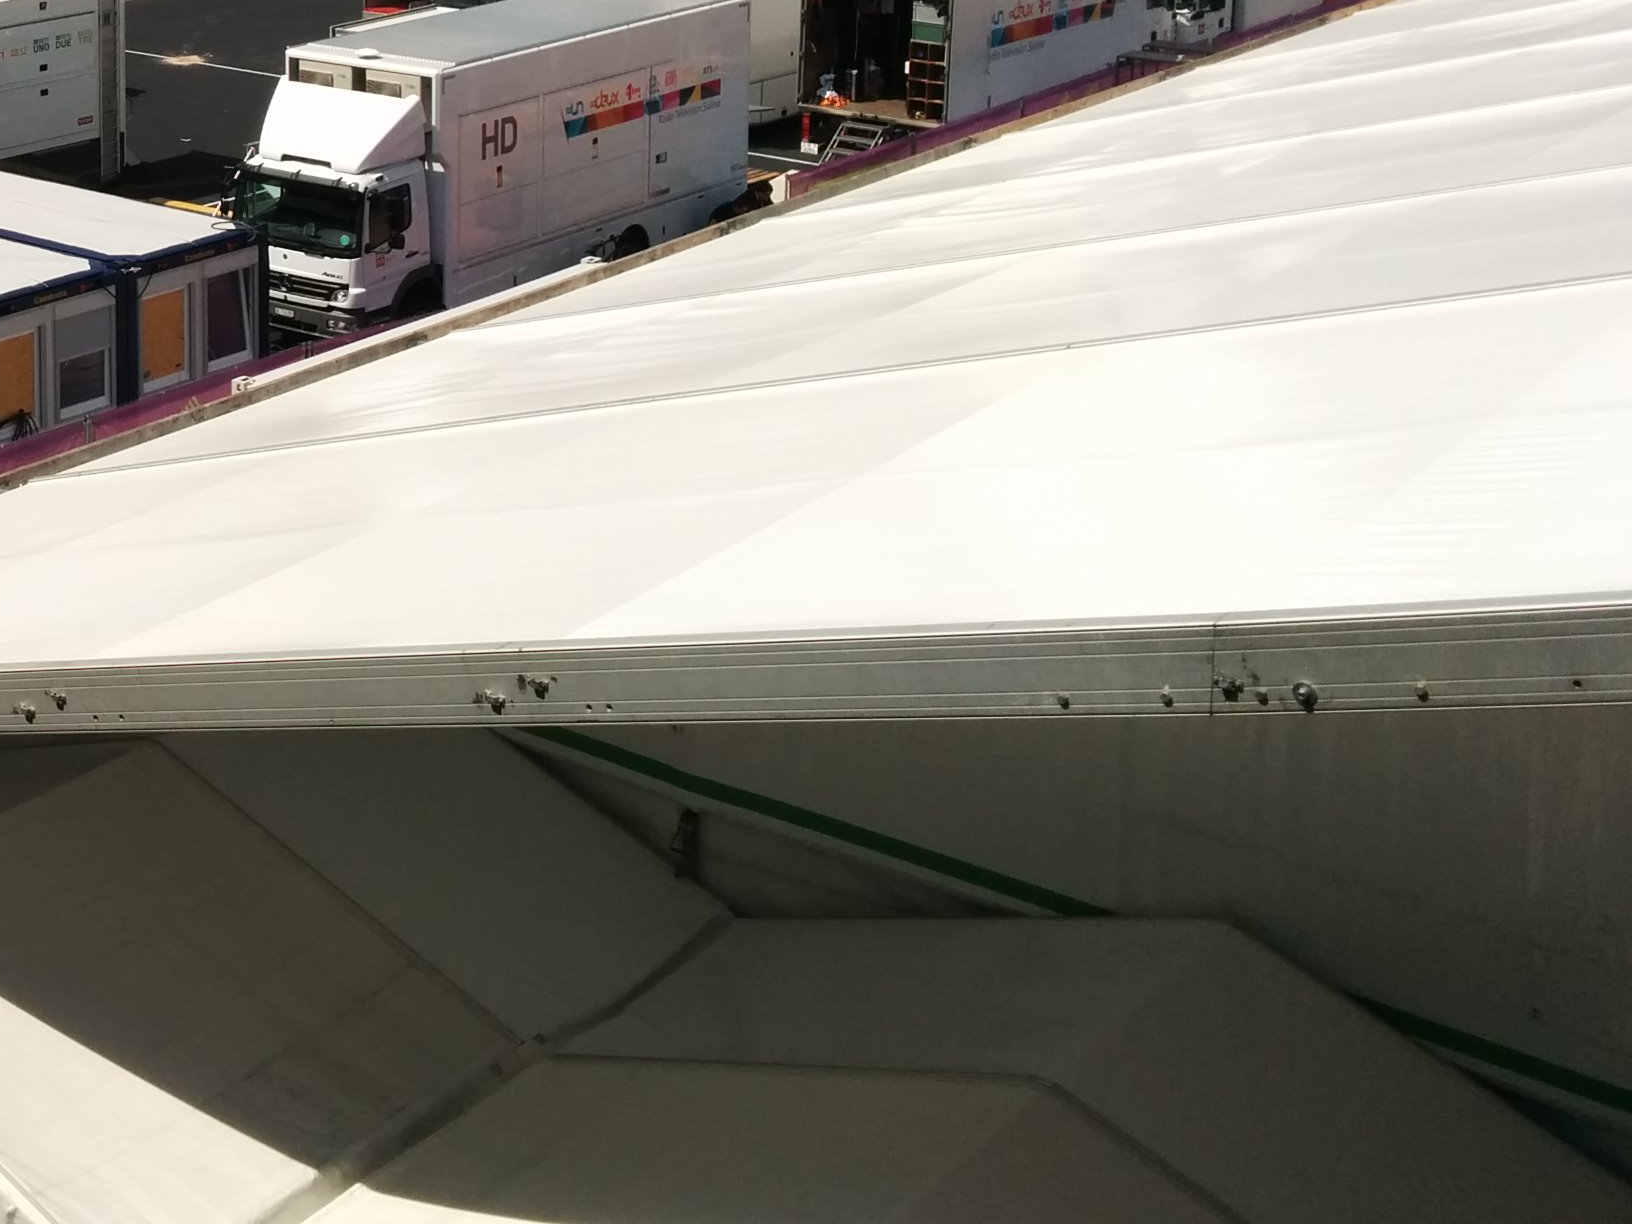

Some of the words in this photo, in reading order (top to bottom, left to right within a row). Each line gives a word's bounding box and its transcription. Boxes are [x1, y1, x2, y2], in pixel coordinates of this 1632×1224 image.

[33, 43, 50, 53] UNO
[55, 38, 72, 49] DUE
[481, 115, 518, 160] HD
